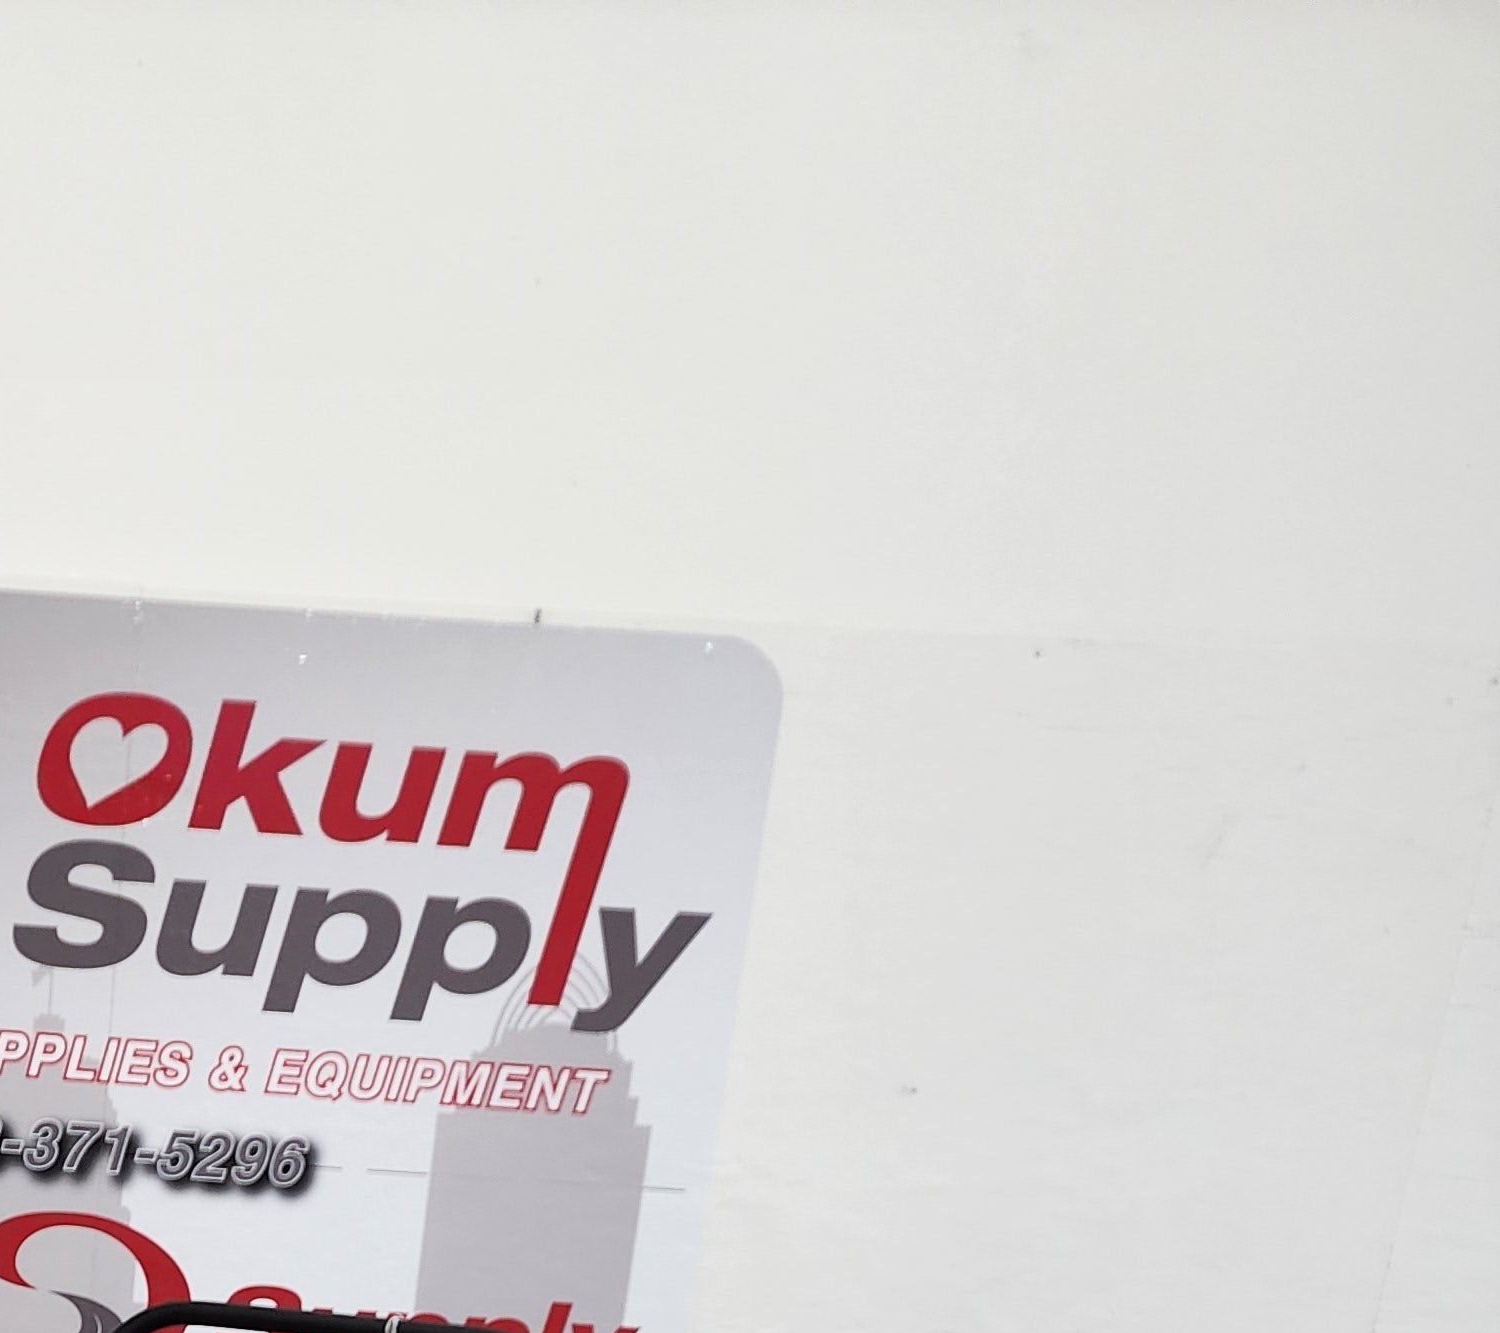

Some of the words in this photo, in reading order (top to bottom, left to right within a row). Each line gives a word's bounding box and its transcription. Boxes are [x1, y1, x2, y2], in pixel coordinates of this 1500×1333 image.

[37, 691, 629, 858] Okum
[13, 838, 712, 1033] Supply
[208, 1045, 248, 1092] &
[264, 1047, 612, 1115] EQUIPMENT
